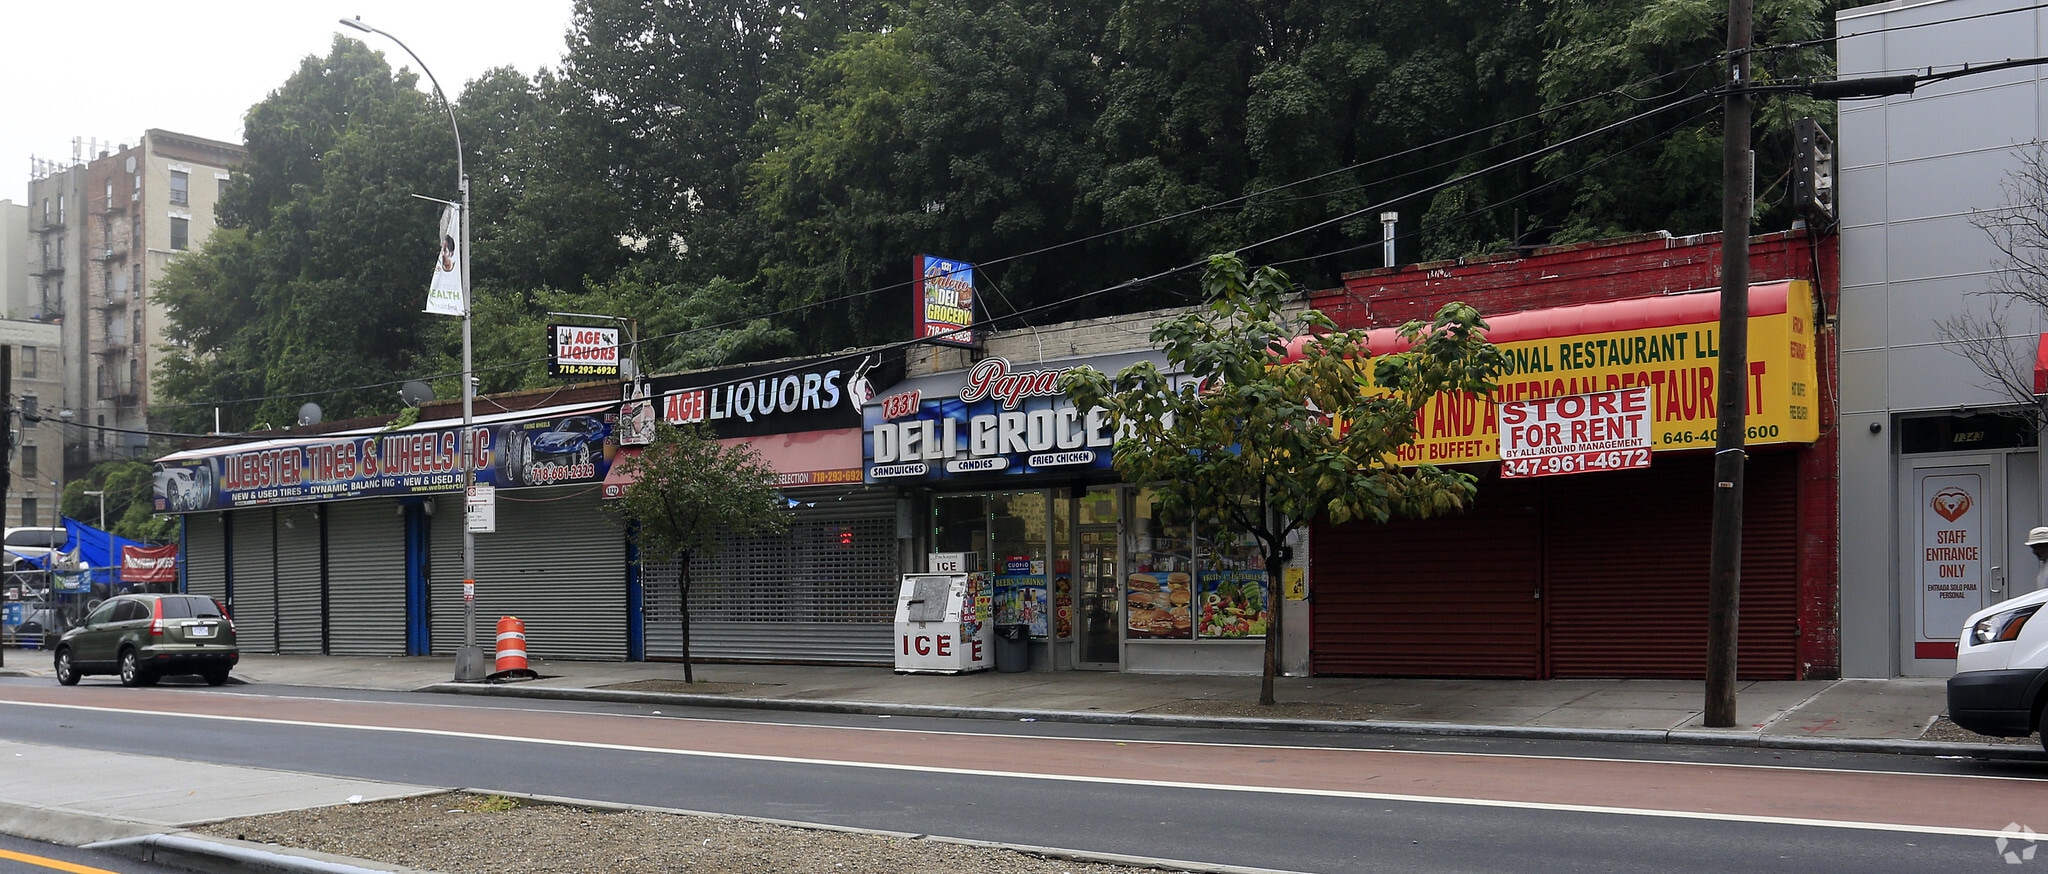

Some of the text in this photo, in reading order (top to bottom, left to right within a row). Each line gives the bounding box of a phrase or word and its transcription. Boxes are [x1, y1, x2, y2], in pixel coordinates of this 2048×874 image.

[937, 289, 959, 307] DELI
[927, 304, 970, 325] GROCERY
[575, 331, 600, 345] AGE
[560, 345, 616, 361] LIQUORS
[1561, 331, 1688, 371] RESTAURANT
[666, 369, 842, 423] AGE LIQUORS
[881, 389, 922, 420] 1331
[1431, 387, 1477, 439] AND
[1502, 387, 1647, 425] STORE
[873, 416, 957, 464] DELI
[1510, 422, 1563, 449] FOR
[1571, 414, 1643, 444] RENT
[1397, 444, 1425, 461] HOT
[1429, 440, 1483, 460] BUFFET
[1506, 438, 1644, 458] BY ALL AROUND MANAGEMENT
[224, 446, 302, 493] WEBSTER
[306, 440, 357, 484] TIRES
[361, 439, 378, 479] &
[382, 431, 455, 477] WHEELS
[958, 459, 993, 470] CANDIES
[1032, 451, 1090, 465] FRIED CHICKEN
[1504, 449, 1649, 477] 347-961-4672
[532, 463, 595, 481] 718-681-2323
[778, 473, 809, 485] SELECTION
[873, 464, 924, 476] SANDWICHES
[231, 493, 249, 502] NEW
[250, 492, 256, 500] &
[258, 489, 278, 499] USED
[280, 487, 302, 497] TIRES
[310, 483, 348, 494] DYNAMIC
[403, 477, 422, 487] NEW
[424, 476, 430, 485] &
[431, 474, 453, 485] USED
[455, 473, 476, 484] RIS
[1937, 529, 1967, 545] STAFF
[1926, 546, 1978, 561] ENTRANCE
[936, 561, 957, 572] ICE
[1939, 563, 1966, 578] ONLY
[995, 579, 1014, 588] BEERS
[1022, 577, 1045, 586] DRINKS
[1927, 583, 1977, 592] ENTRADA SOLO PARA
[1939, 591, 1965, 599] PERSONAL
[902, 634, 952, 657] ICE
